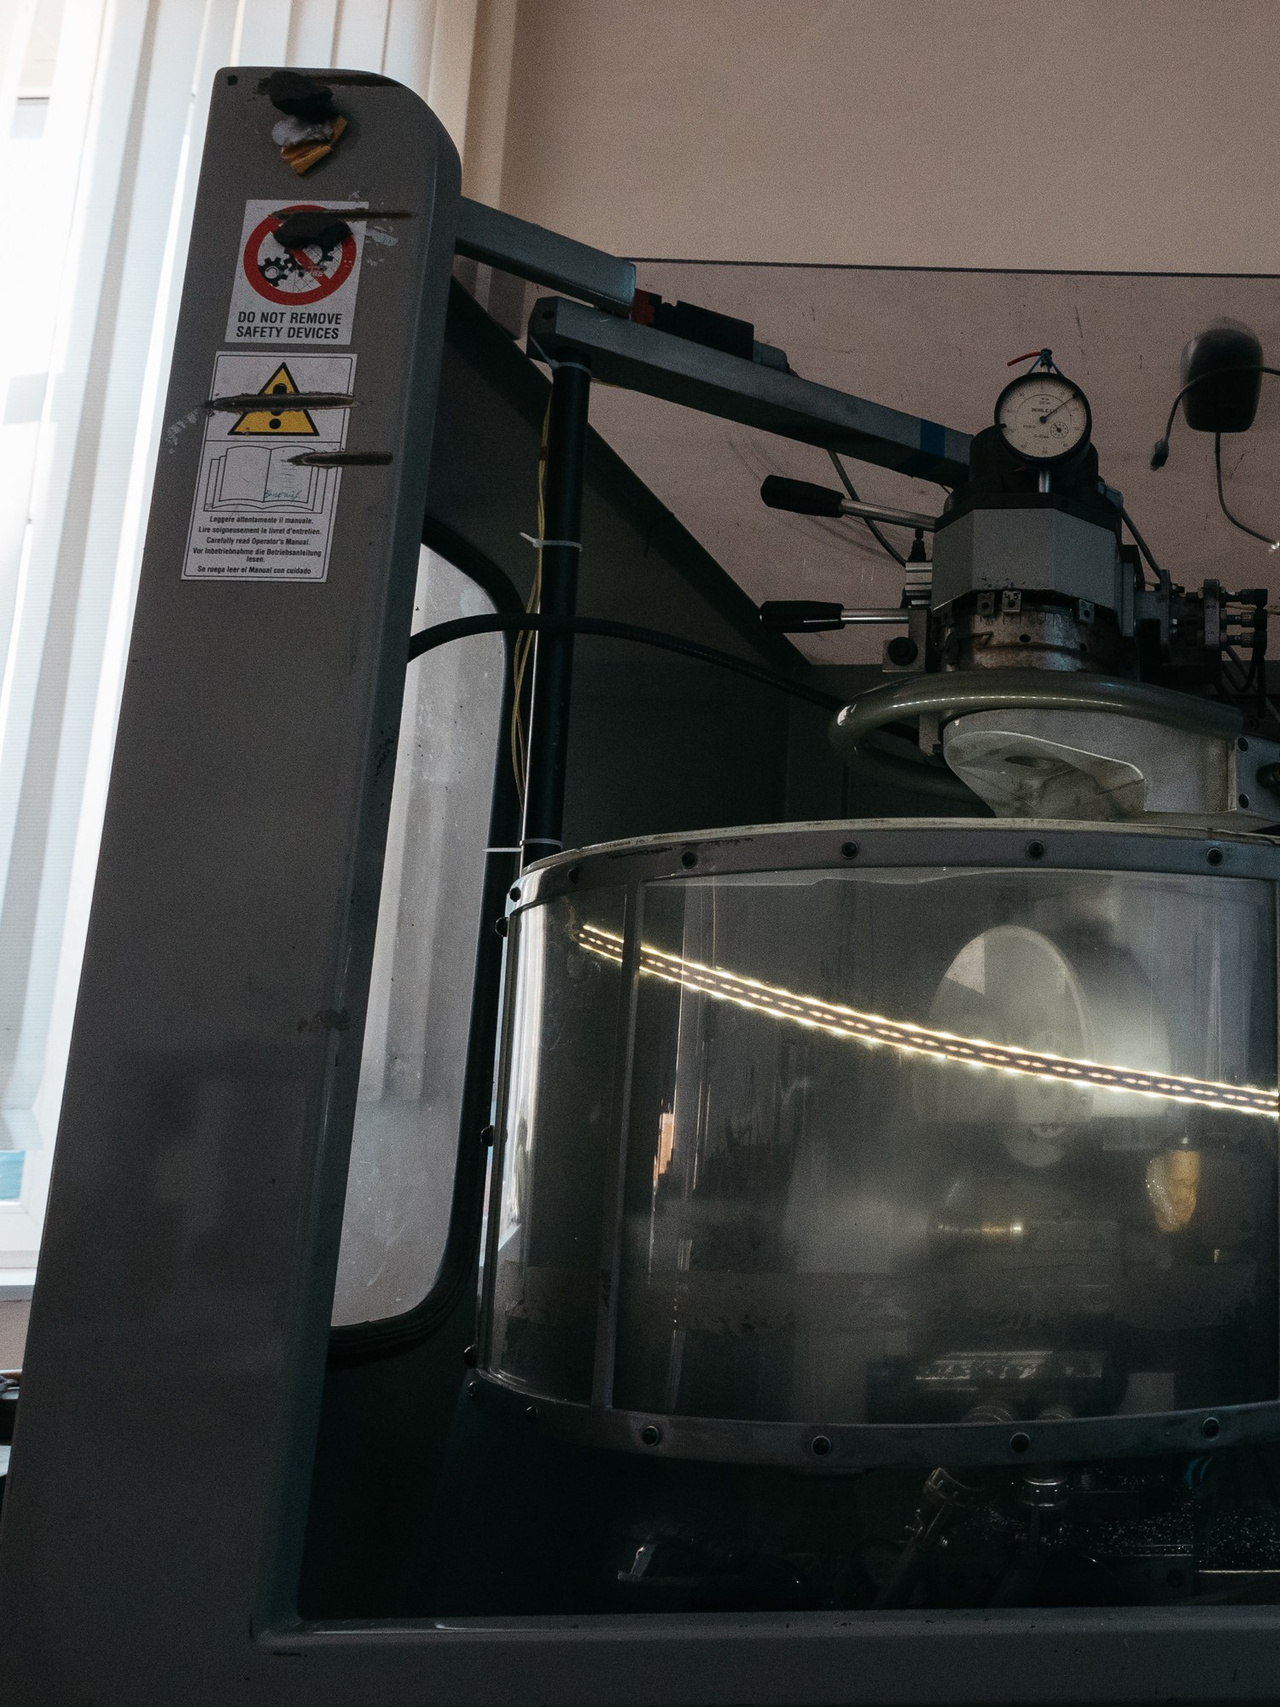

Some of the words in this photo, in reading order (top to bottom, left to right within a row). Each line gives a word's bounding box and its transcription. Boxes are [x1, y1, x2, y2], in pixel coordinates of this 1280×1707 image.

[238, 311, 255, 323] DO
[260, 312, 286, 323] NOT
[290, 312, 342, 325] REMOVE
[236, 326, 283, 338] SAFETY
[287, 326, 339, 340] DEVICES
[209, 515, 235, 524] Leggere
[236, 516, 277, 524] attentamente
[279, 516, 284, 524] il
[285, 517, 314, 525] manuale.
[212, 526, 260, 535] soigneusement
[268, 527, 285, 535] livret
[286, 527, 322, 535] d'entretien.
[206, 536, 235, 546] Carefully
[235, 537, 250, 545] read
[251, 537, 284, 546] Operator's
[285, 538, 311, 546] Manual.
[192, 547, 203, 555] Vor
[204, 547, 254, 556] Inbetriebnahme
[266, 548, 322, 558] Betriebsanleitung
[207, 567, 226, 575] ruega
[226, 566, 240, 574] leer
[240, 566, 247, 574] el
[248, 567, 272, 575] Manual
[286, 567, 312, 575] cuidado
